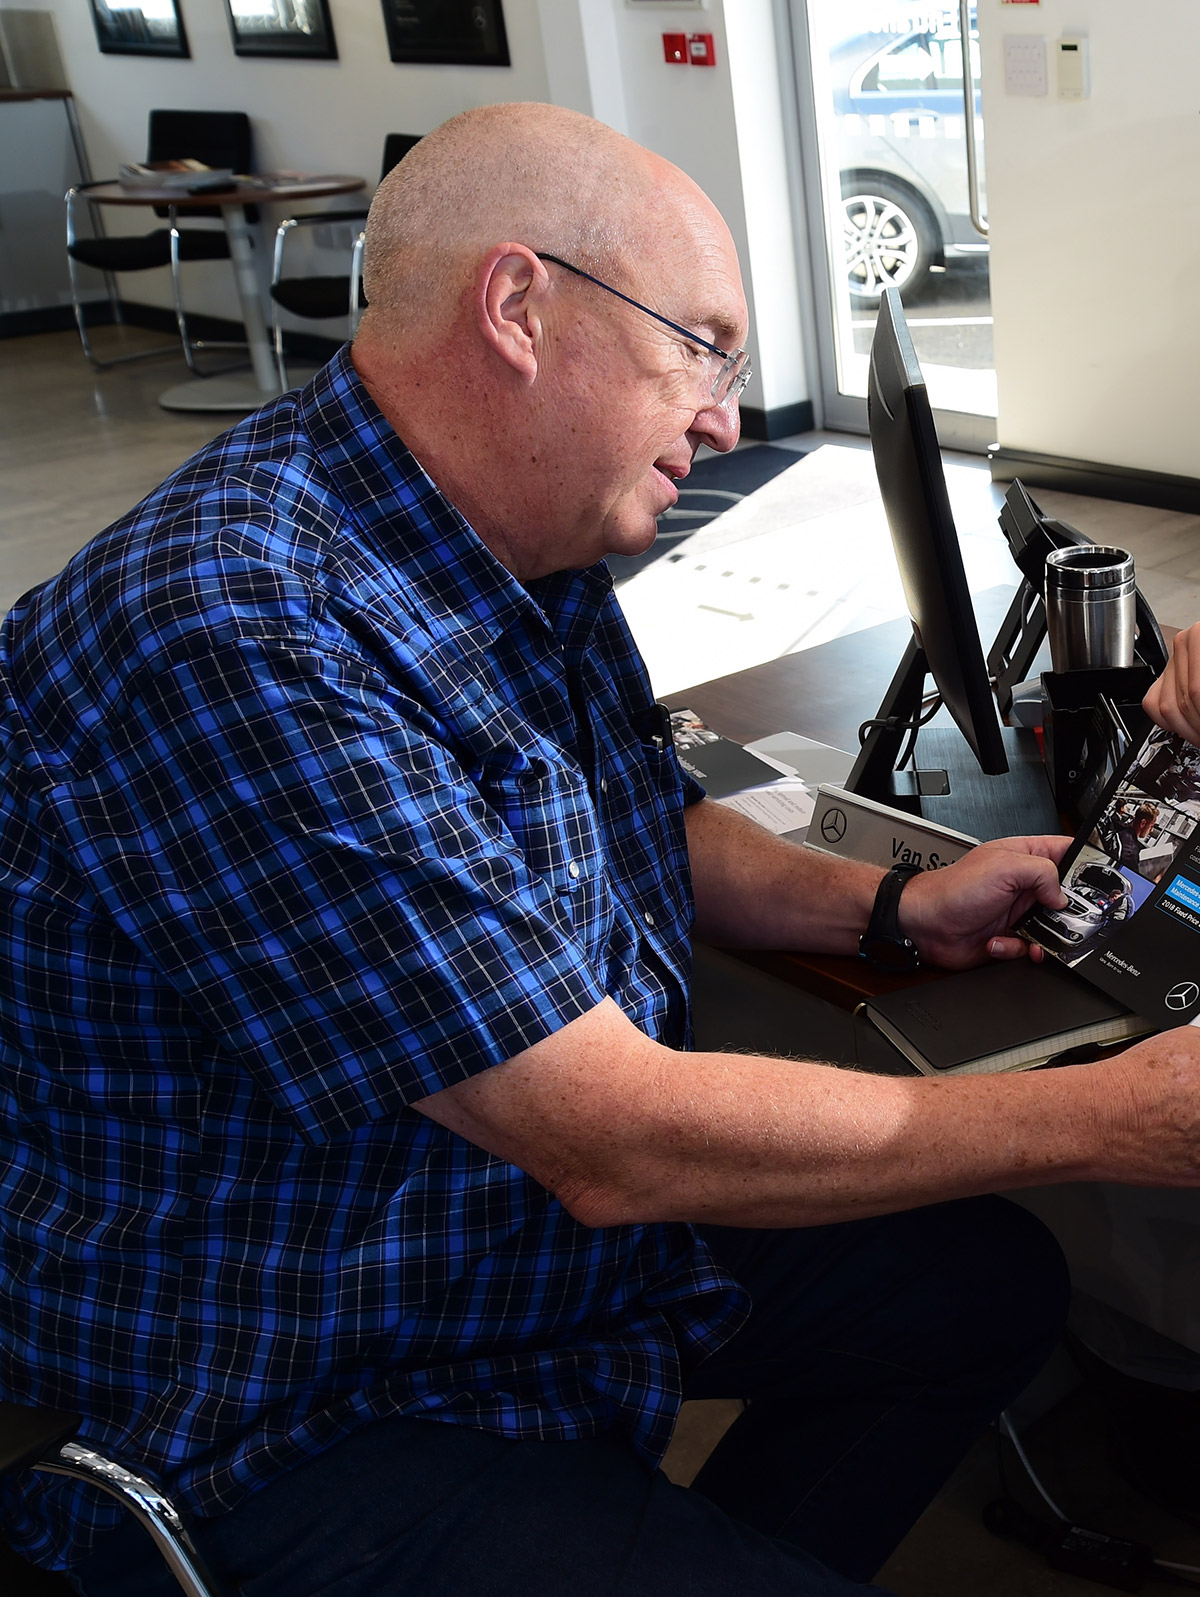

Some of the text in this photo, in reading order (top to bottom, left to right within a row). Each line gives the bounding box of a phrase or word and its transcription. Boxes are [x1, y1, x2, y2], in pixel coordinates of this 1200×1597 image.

[892, 837, 922, 866] Van
[1170, 886, 1200, 907] Maintenance
[1161, 899, 1175, 910] 2018
[1173, 906, 1187, 918] Fixed
[1186, 913, 1200, 925] Price
[1103, 949, 1141, 977] Mercedes-Benz
